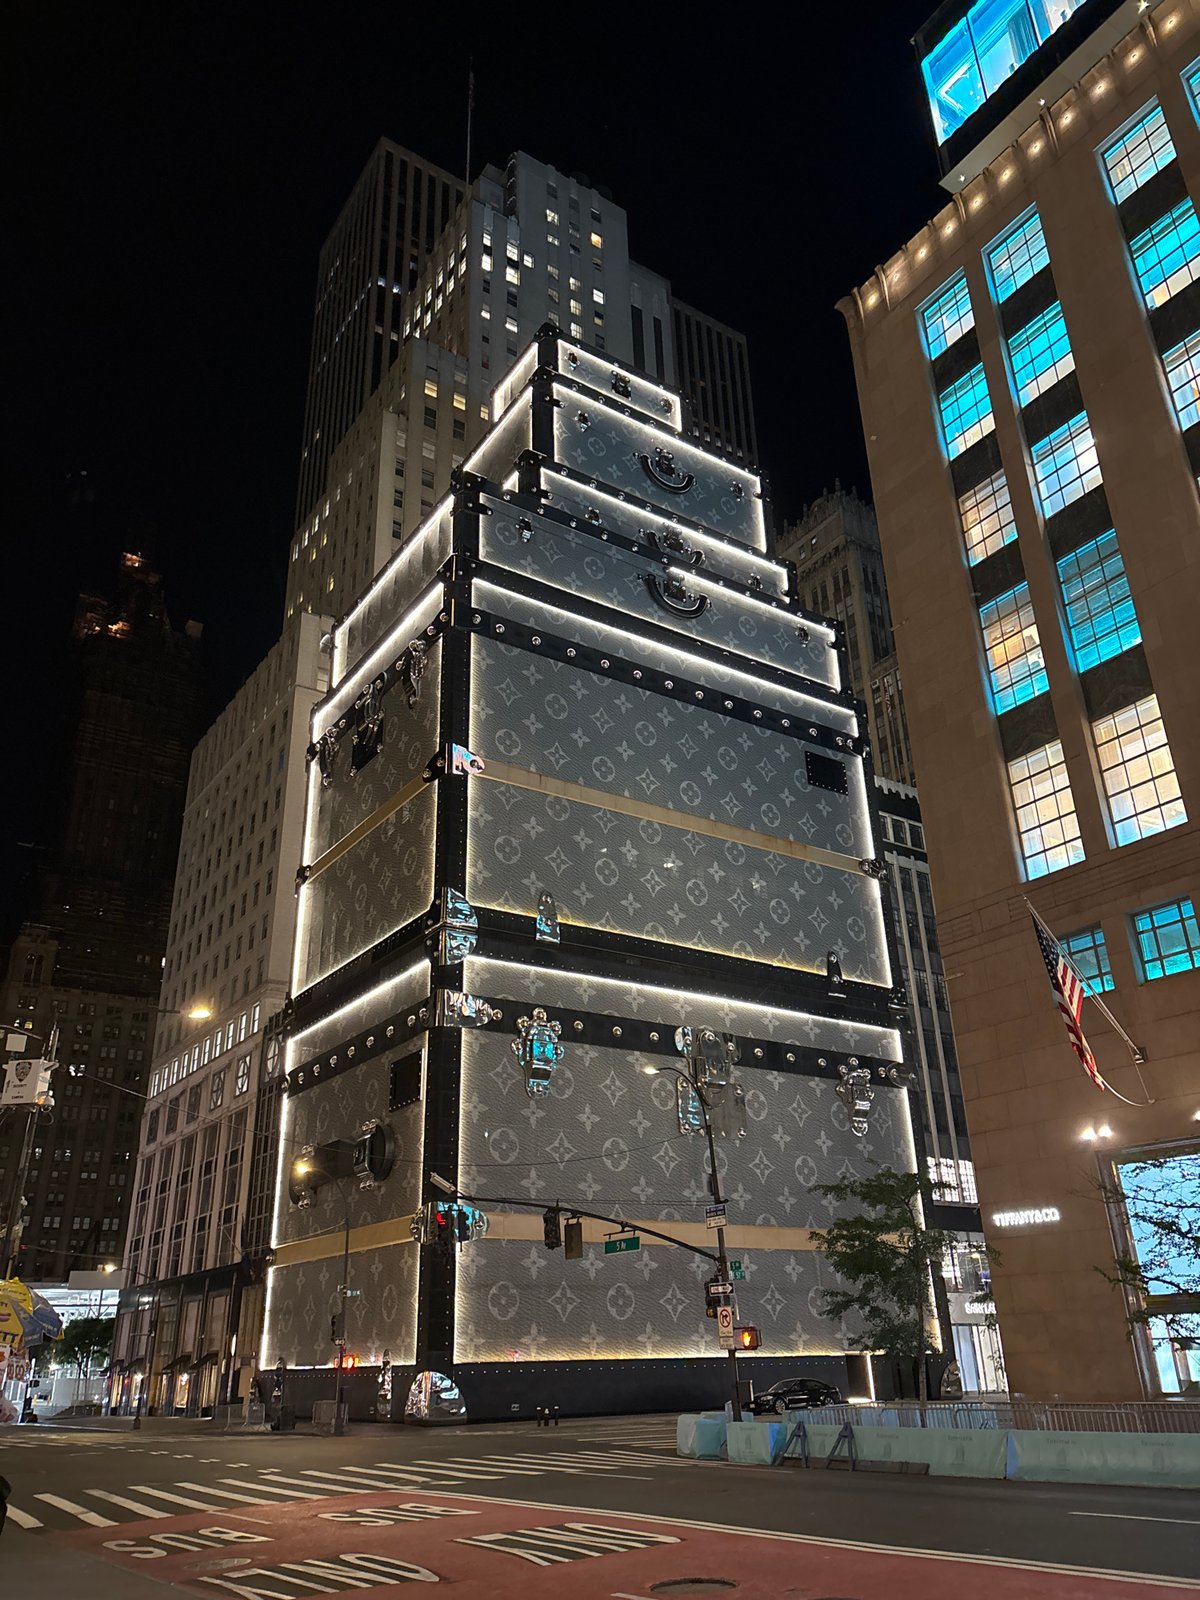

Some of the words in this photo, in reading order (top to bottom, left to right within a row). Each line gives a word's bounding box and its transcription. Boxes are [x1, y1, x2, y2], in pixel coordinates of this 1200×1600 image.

[616, 1241, 621, 1251] 5
[318, 1503, 482, 1526] BUS
[102, 1527, 275, 1559] BUS
[453, 1523, 681, 1566] ONLY
[197, 1553, 440, 1600] ONLY
